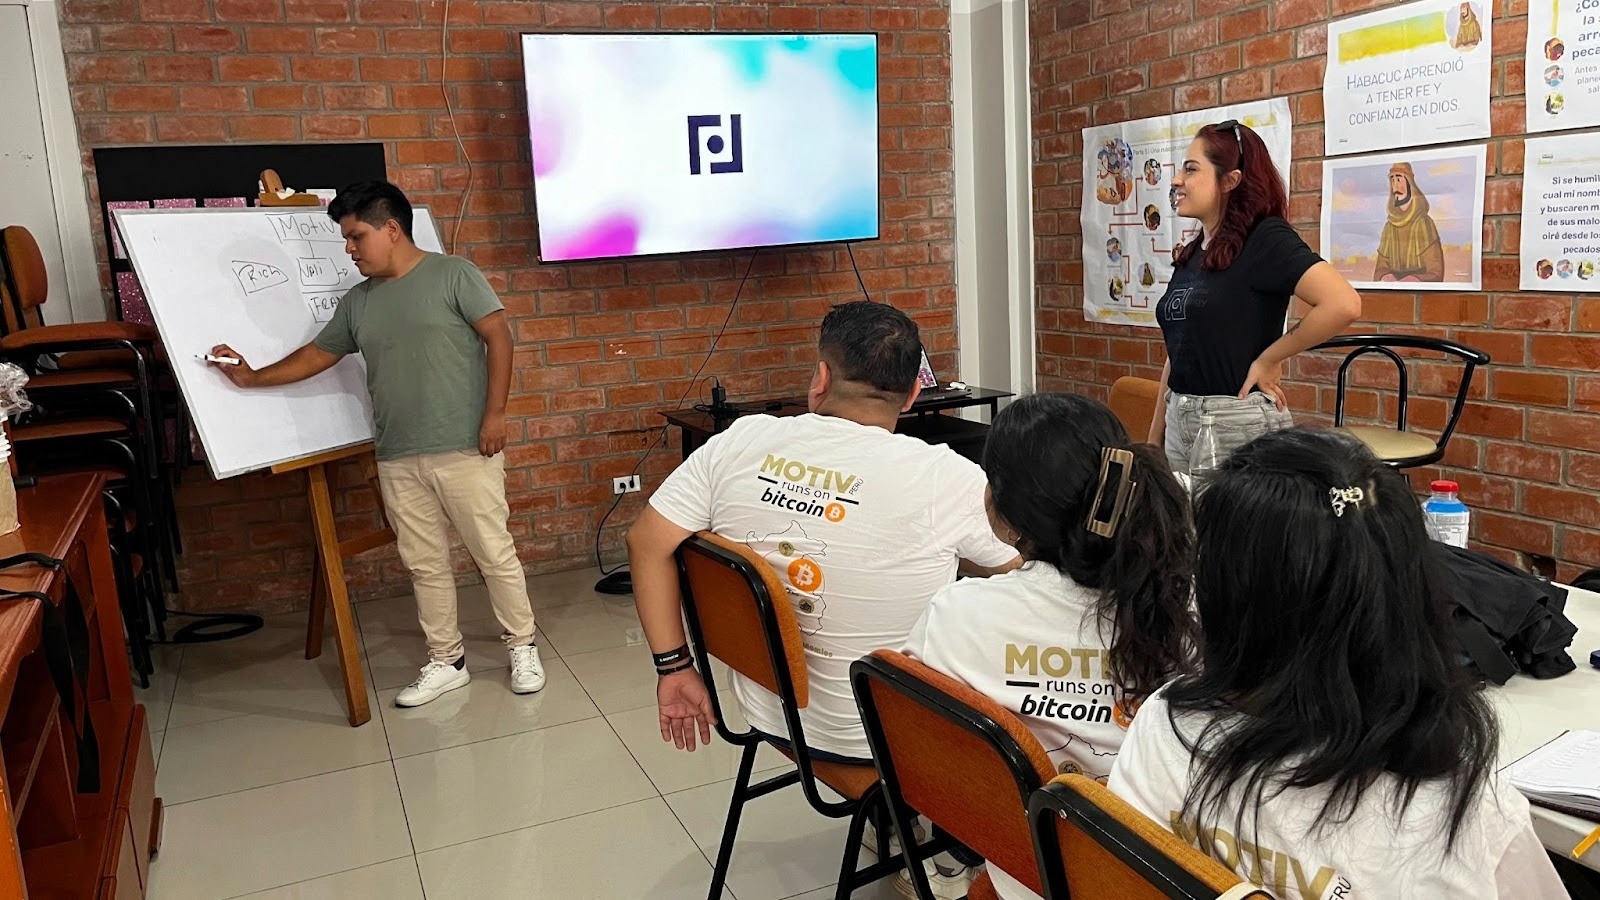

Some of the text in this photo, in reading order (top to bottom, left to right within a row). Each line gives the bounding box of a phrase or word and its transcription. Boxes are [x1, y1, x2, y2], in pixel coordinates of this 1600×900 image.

[1583, 15, 1595, 25] la
[1578, 31, 1600, 42] arr
[1347, 56, 1464, 90] HABACUC APRENDIÓ
[1575, 65, 1598, 74] Antes
[1365, 82, 1442, 105] A TENER FE Y
[1348, 98, 1460, 126] CONFIANZA EN DIOS.
[1552, 176, 1561, 185] Si
[1542, 190, 1562, 199] cual
[1563, 190, 1575, 198] mi
[1540, 207, 1546, 215] y
[1547, 205, 1589, 213] buscaren
[1547, 218, 1558, 226] de
[1542, 231, 1560, 240] oiré
[1561, 231, 1589, 239] desde
[759, 453, 857, 494] MOTIV
[781, 480, 830, 501] runs on
[848, 478, 864, 496] PERÚ
[760, 487, 825, 517] bitcoin
[1005, 643, 1112, 680] MOTI
[1046, 680, 1115, 696] runs on
[1020, 694, 1112, 723] bitcoin
